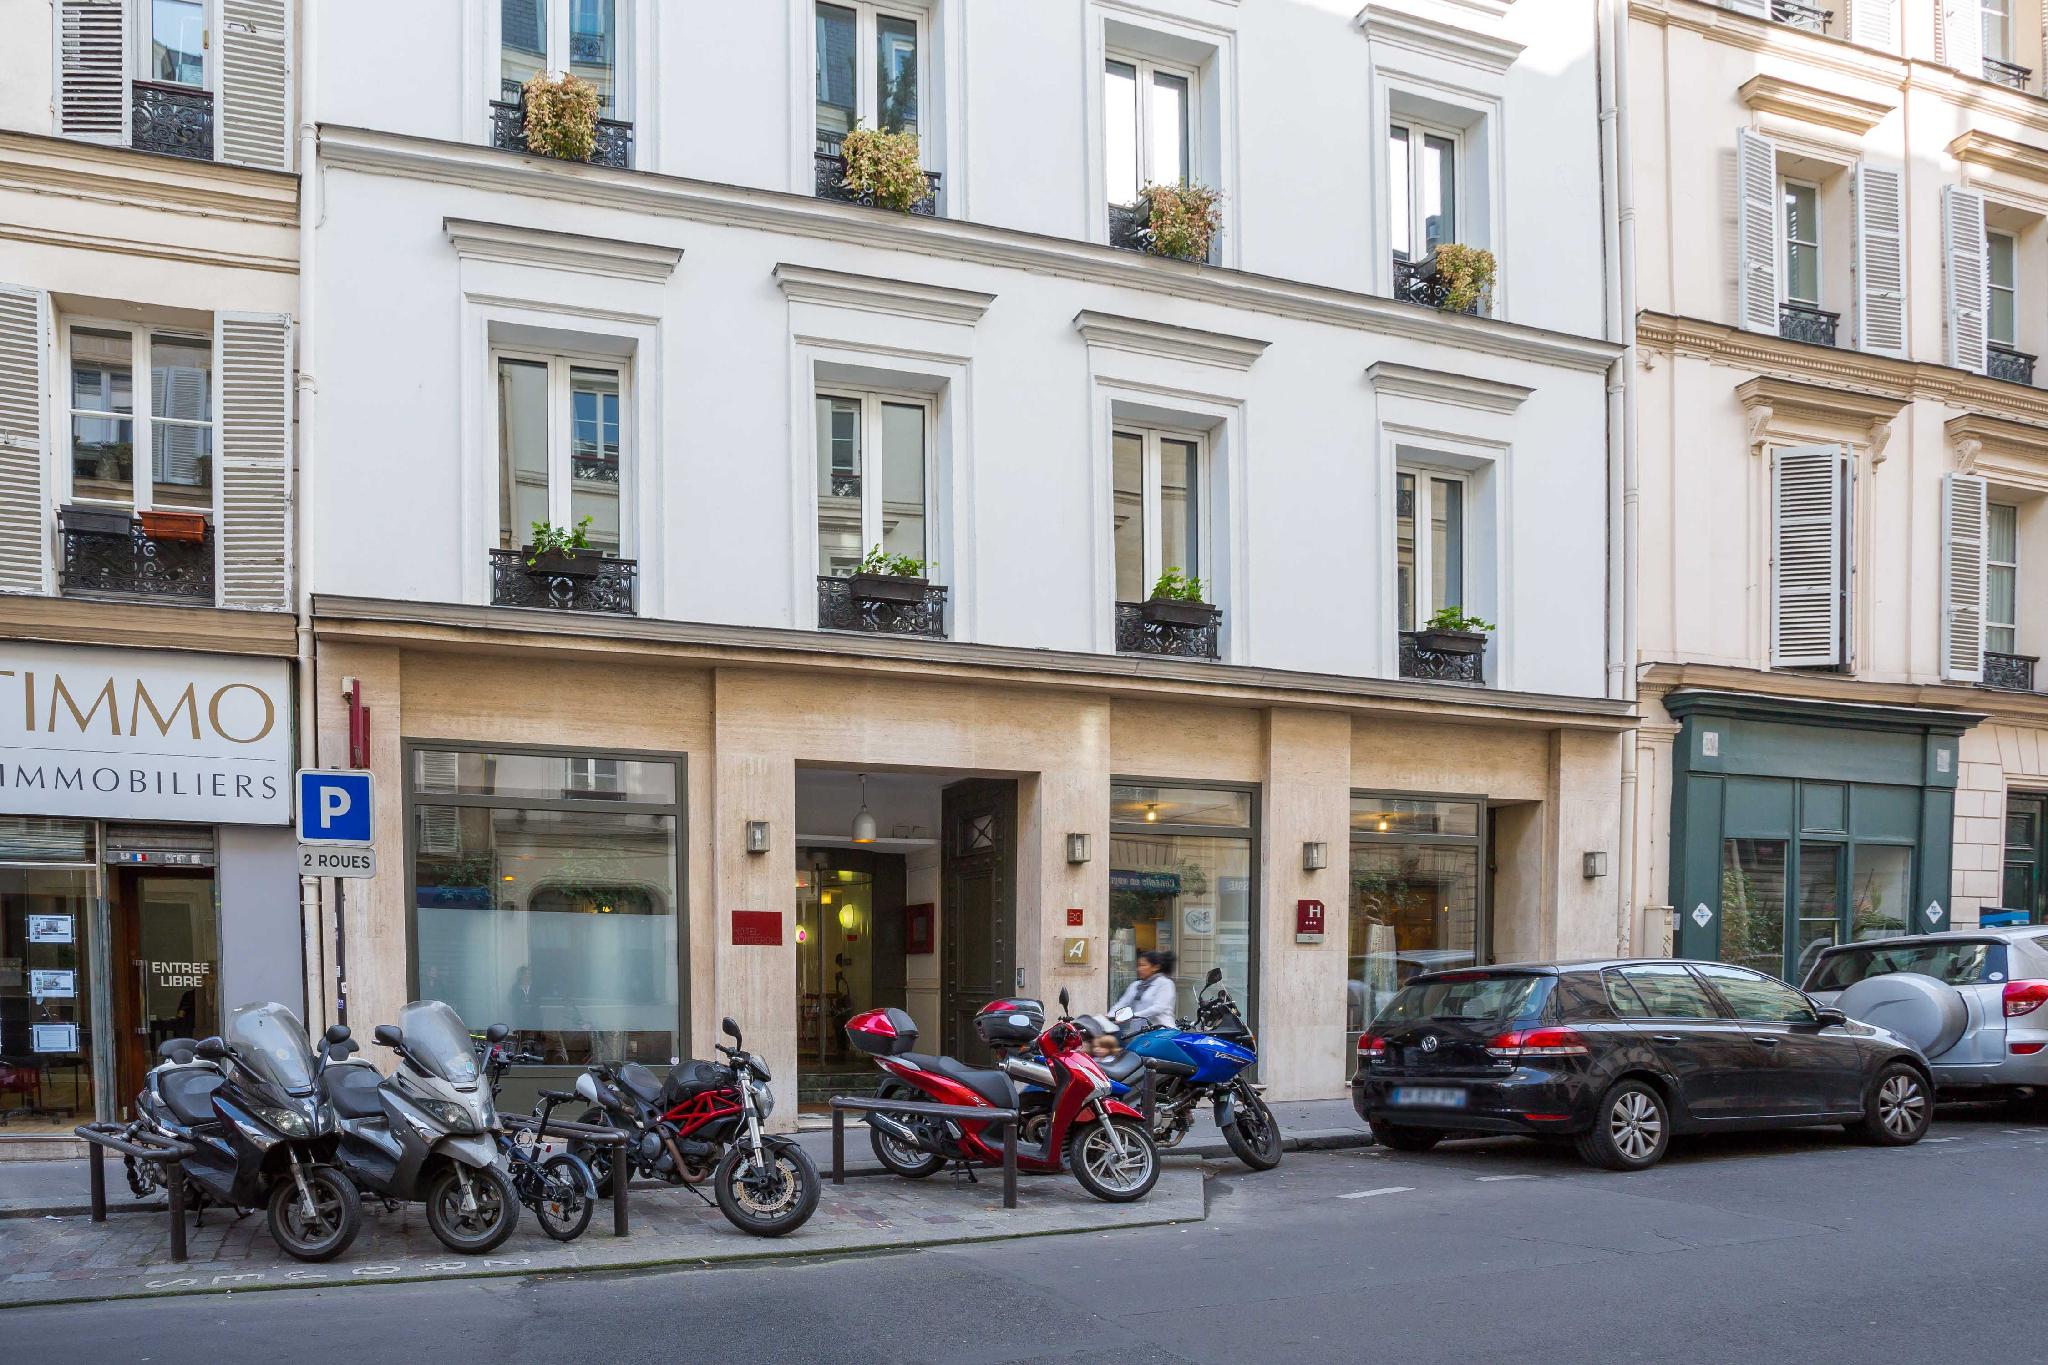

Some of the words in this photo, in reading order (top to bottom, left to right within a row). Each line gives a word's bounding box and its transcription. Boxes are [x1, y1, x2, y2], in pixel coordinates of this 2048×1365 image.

[0, 671, 276, 744] IMMO
[320, 786, 352, 829] P
[303, 854, 313, 867] 2
[318, 853, 371, 869] ROUES
[1069, 912, 1082, 922] 30
[1309, 905, 1321, 918] H
[152, 961, 210, 975] ENTREE
[161, 975, 203, 988] LIBRE
